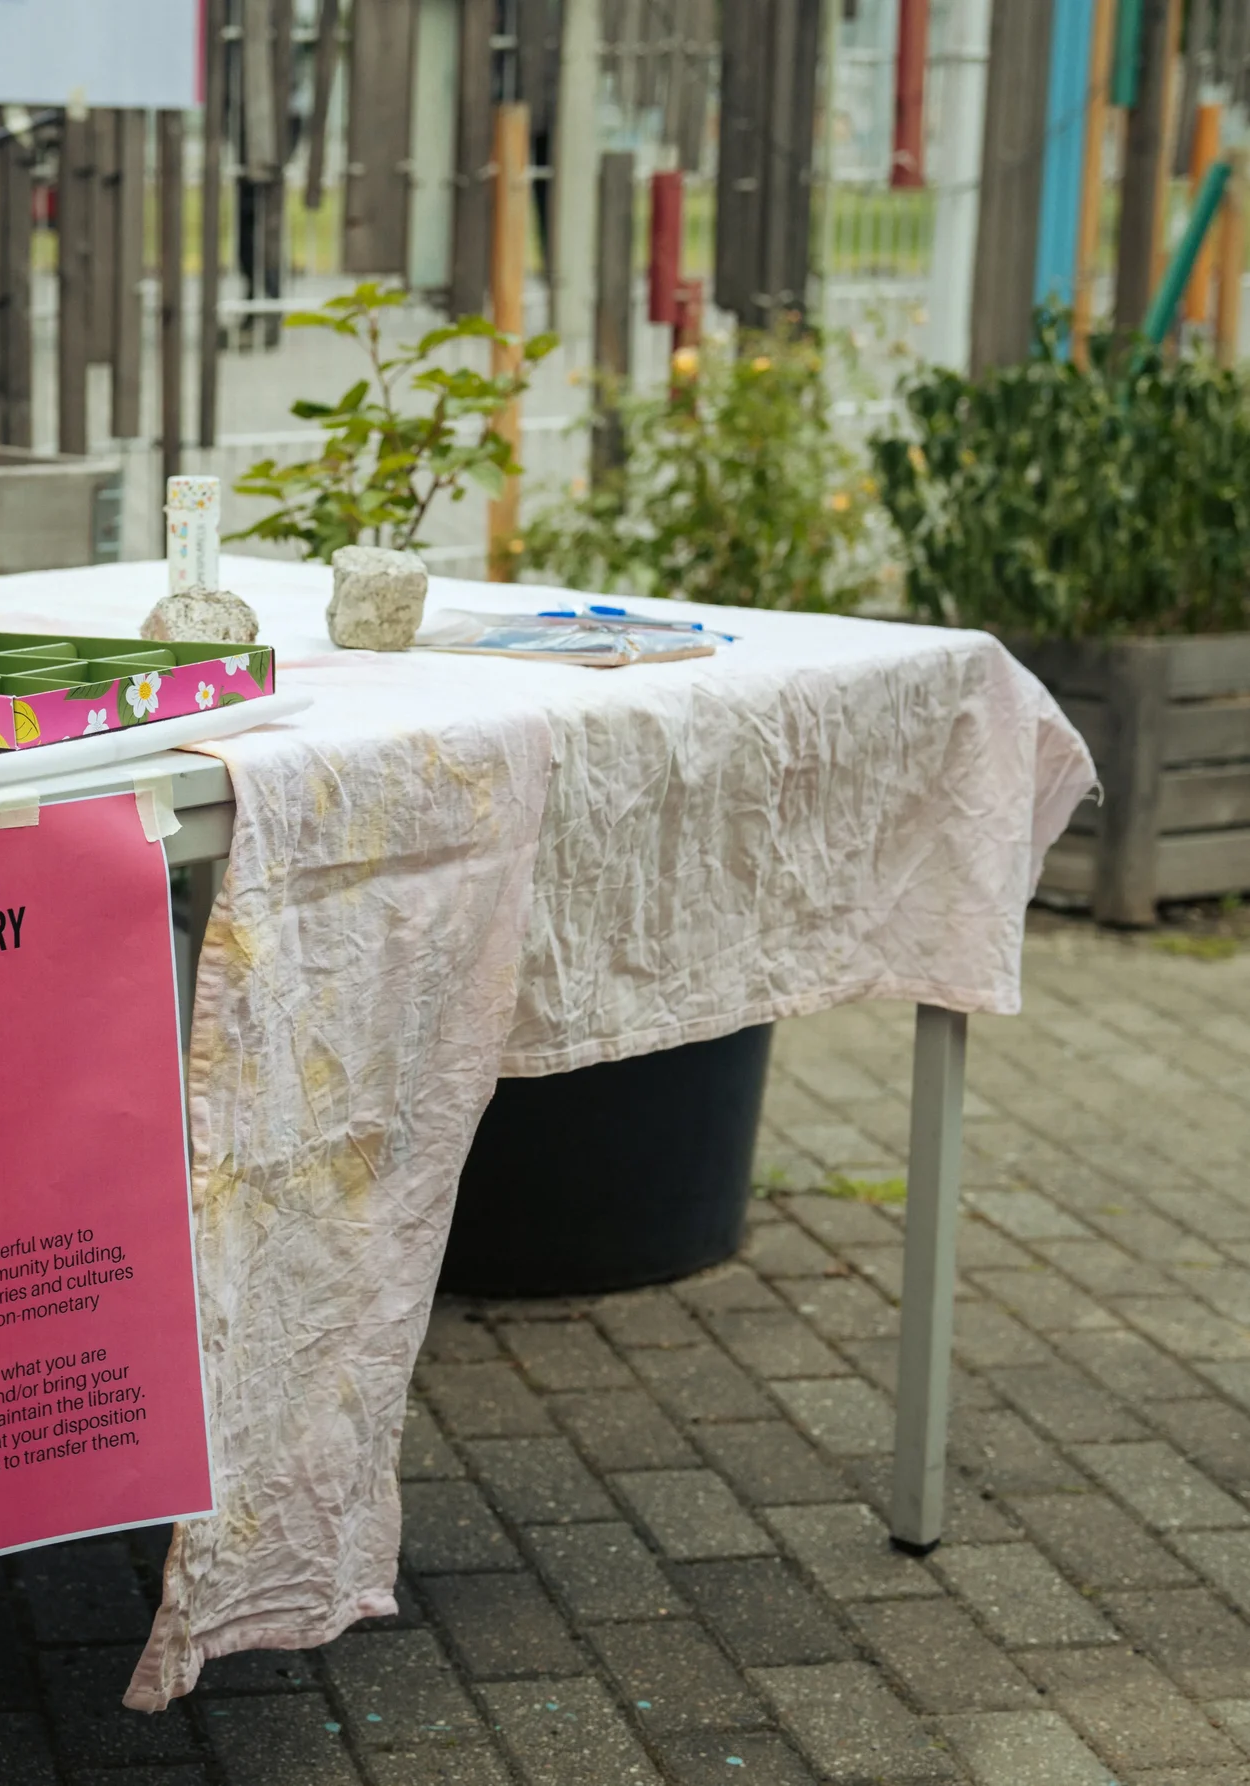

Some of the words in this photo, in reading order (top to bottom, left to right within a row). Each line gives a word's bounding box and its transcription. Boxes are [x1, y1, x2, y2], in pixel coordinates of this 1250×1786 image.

[39, 1232, 74, 1251] way
[76, 1228, 94, 1244] to
[53, 1245, 126, 1271] building,
[30, 1275, 63, 1297] and
[66, 1266, 134, 1290] cultures
[0, 1359, 42, 1381] what
[45, 1354, 76, 1376] you
[80, 1348, 107, 1365] are
[43, 1374, 87, 1395] bring
[90, 1365, 130, 1389] your
[56, 1396, 84, 1414] the
[88, 1386, 146, 1408] library.
[11, 1425, 49, 1450] your
[52, 1407, 147, 1437] disposition
[3, 1455, 21, 1470] to
[23, 1439, 88, 1465] transfer
[91, 1431, 140, 1451] them,
